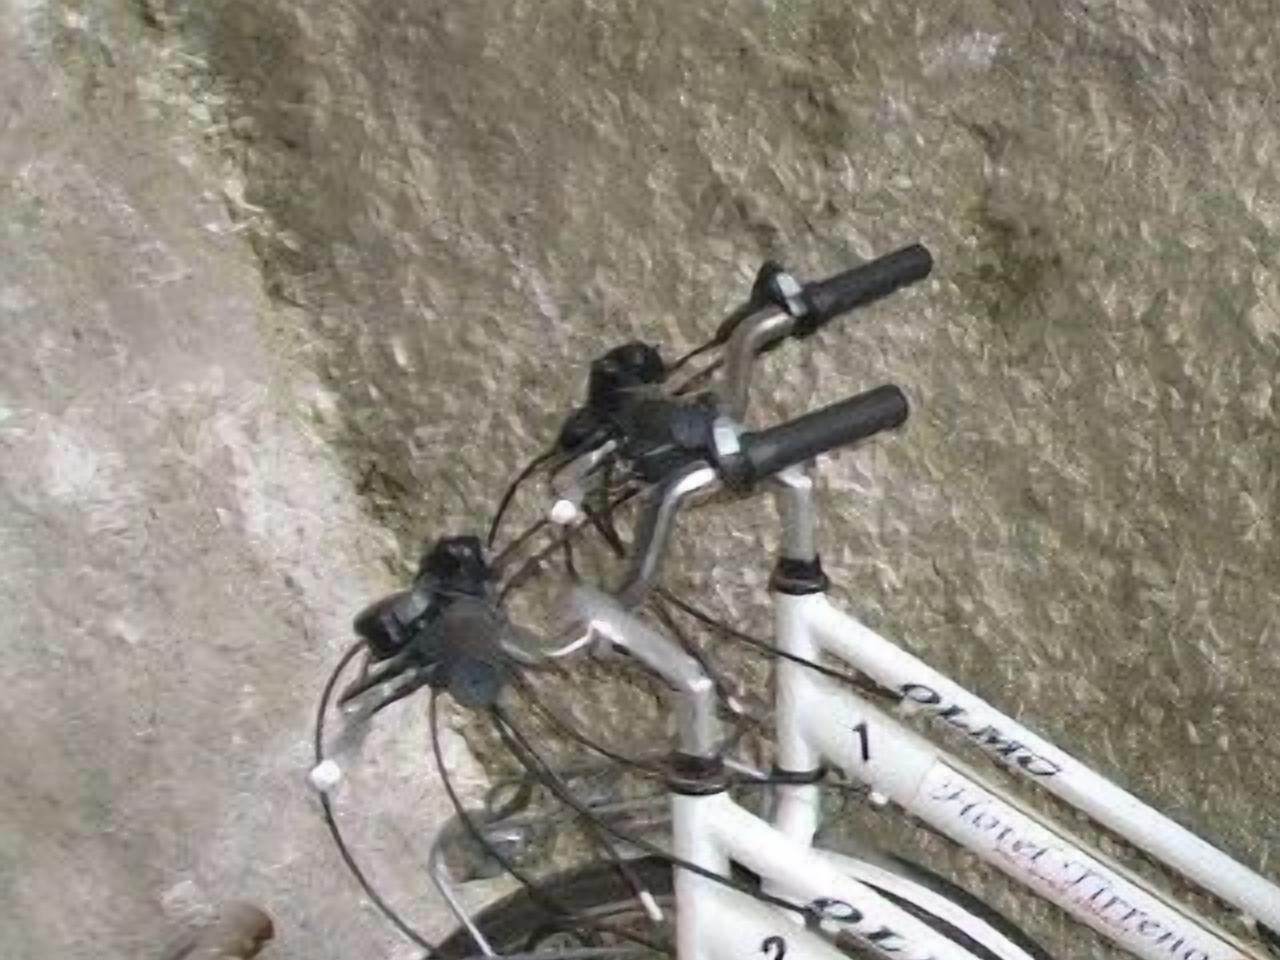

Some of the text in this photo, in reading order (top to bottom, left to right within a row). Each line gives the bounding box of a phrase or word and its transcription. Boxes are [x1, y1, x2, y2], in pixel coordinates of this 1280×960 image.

[852, 723, 869, 762] 1
[900, 684, 1062, 778] OLMO
[931, 781, 1047, 862] Hotel
